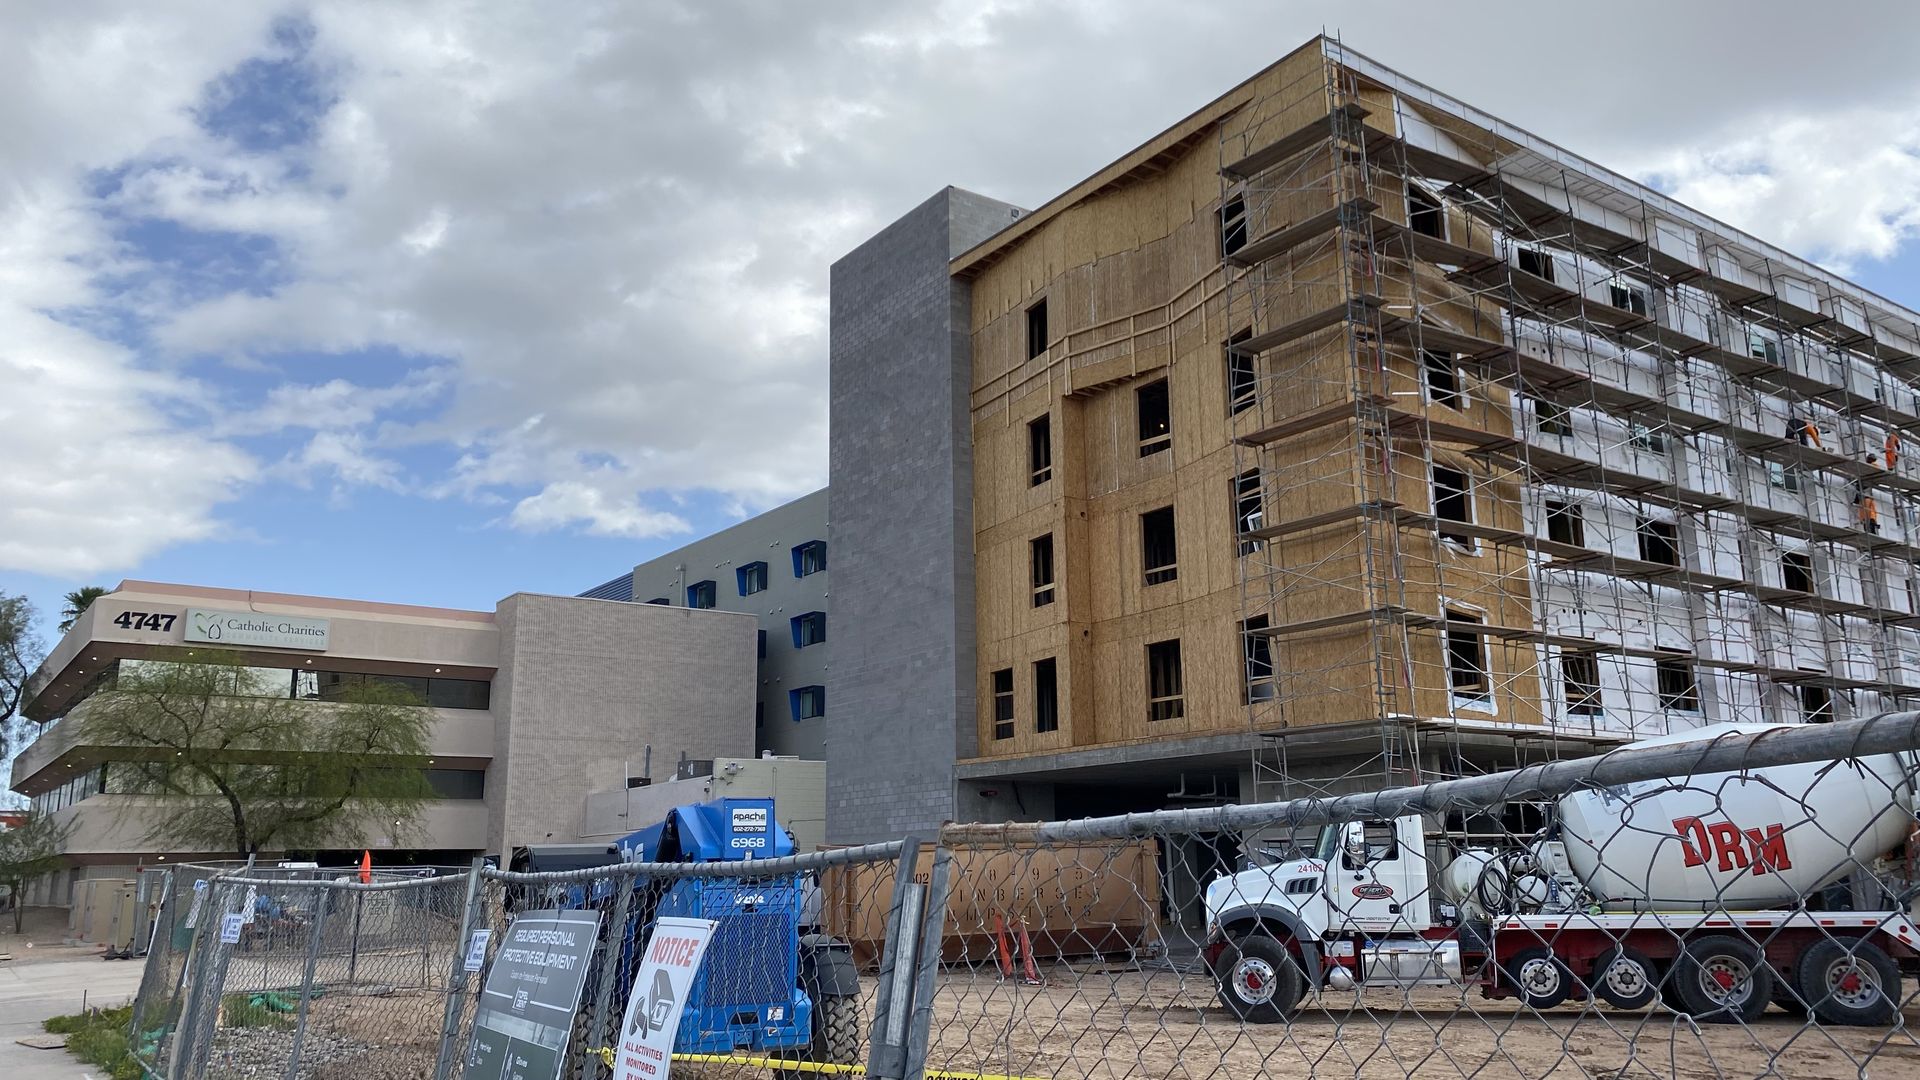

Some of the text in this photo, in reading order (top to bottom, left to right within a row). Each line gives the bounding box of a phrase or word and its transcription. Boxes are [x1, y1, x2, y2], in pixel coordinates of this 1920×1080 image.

[114, 611, 177, 632] 4747
[227, 619, 326, 637] Catholic Charities
[731, 837, 765, 848] 6968
[1672, 815, 1792, 876] DRM
[539, 930, 576, 946] PERSONAL
[502, 948, 577, 970] PROTECTIVE EQUIPMENT
[651, 936, 699, 967] NOTICE
[625, 1041, 663, 1061] ALL ACTIVITIES
[625, 1056, 656, 1075] MONITORED
